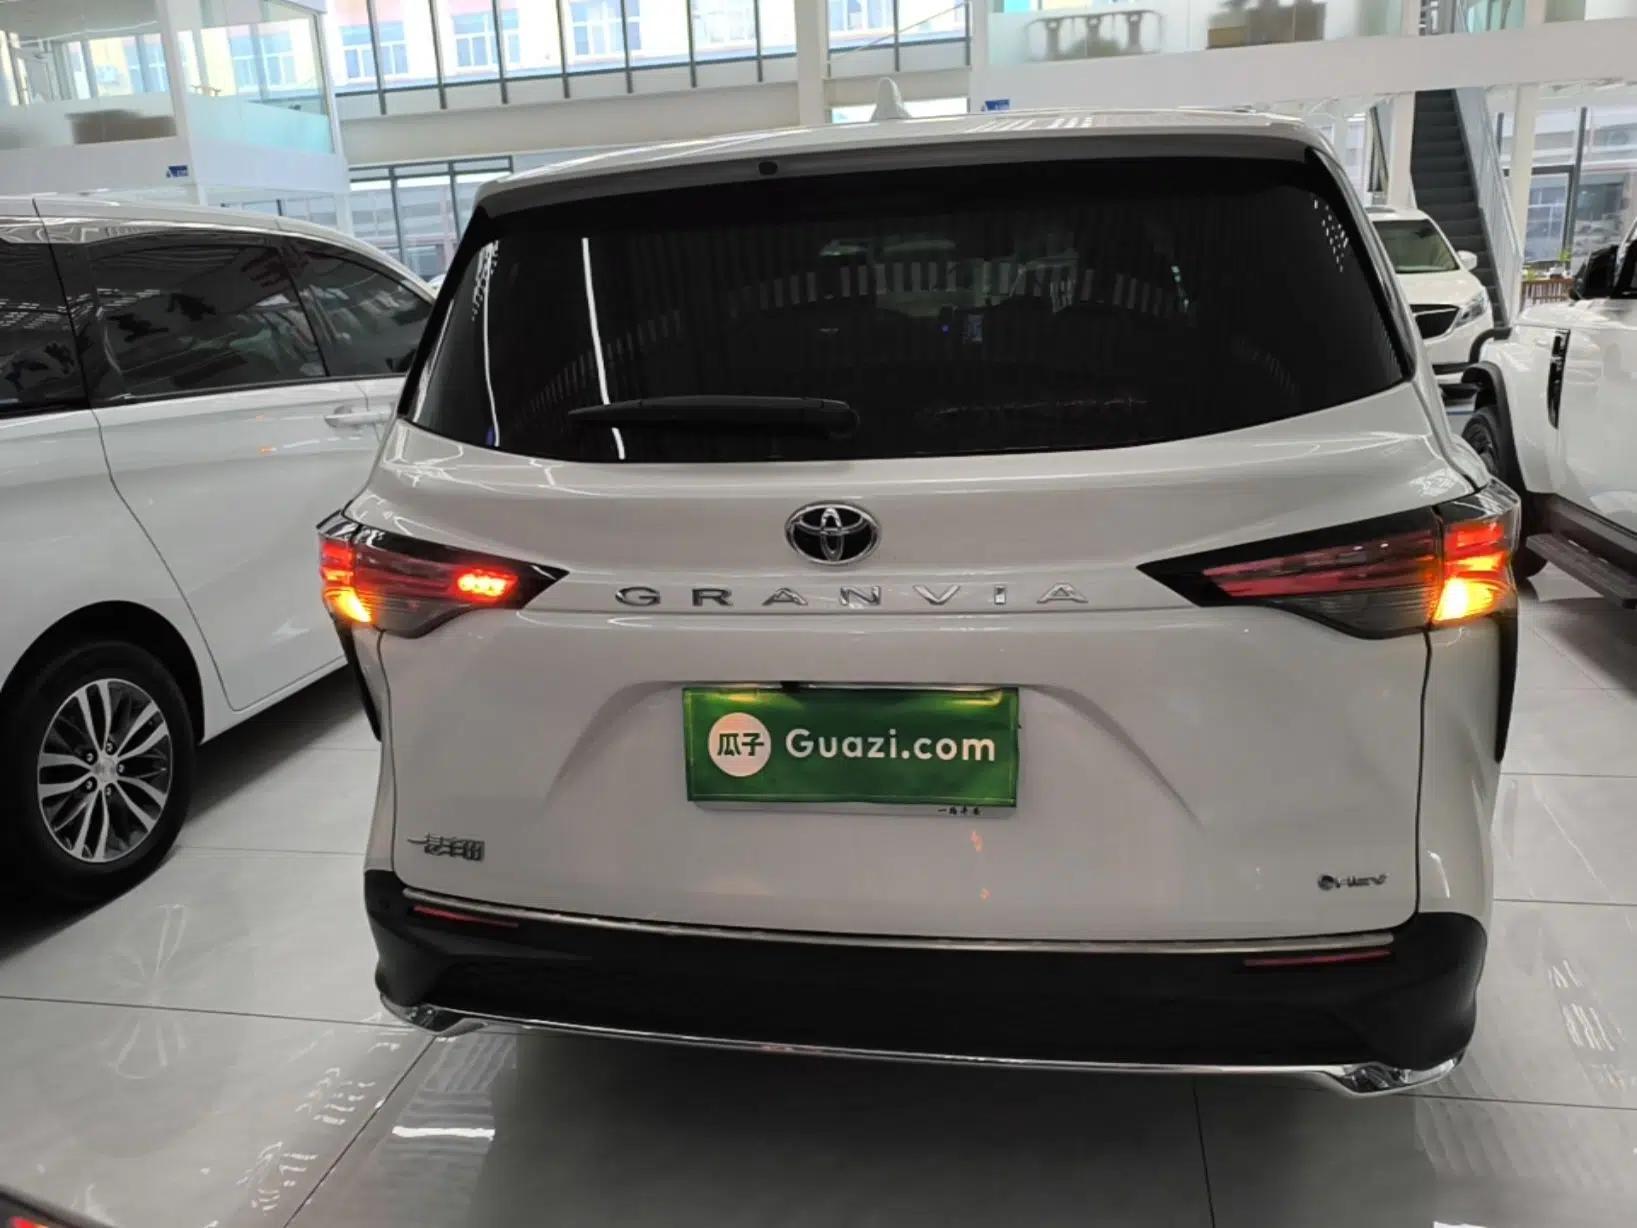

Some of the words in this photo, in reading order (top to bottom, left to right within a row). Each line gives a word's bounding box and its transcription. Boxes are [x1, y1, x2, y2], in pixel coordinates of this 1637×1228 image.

[614, 581, 1089, 608] GRANVIA
[716, 732, 765, 757] 瓜子
[785, 727, 996, 762] Guazi.com
